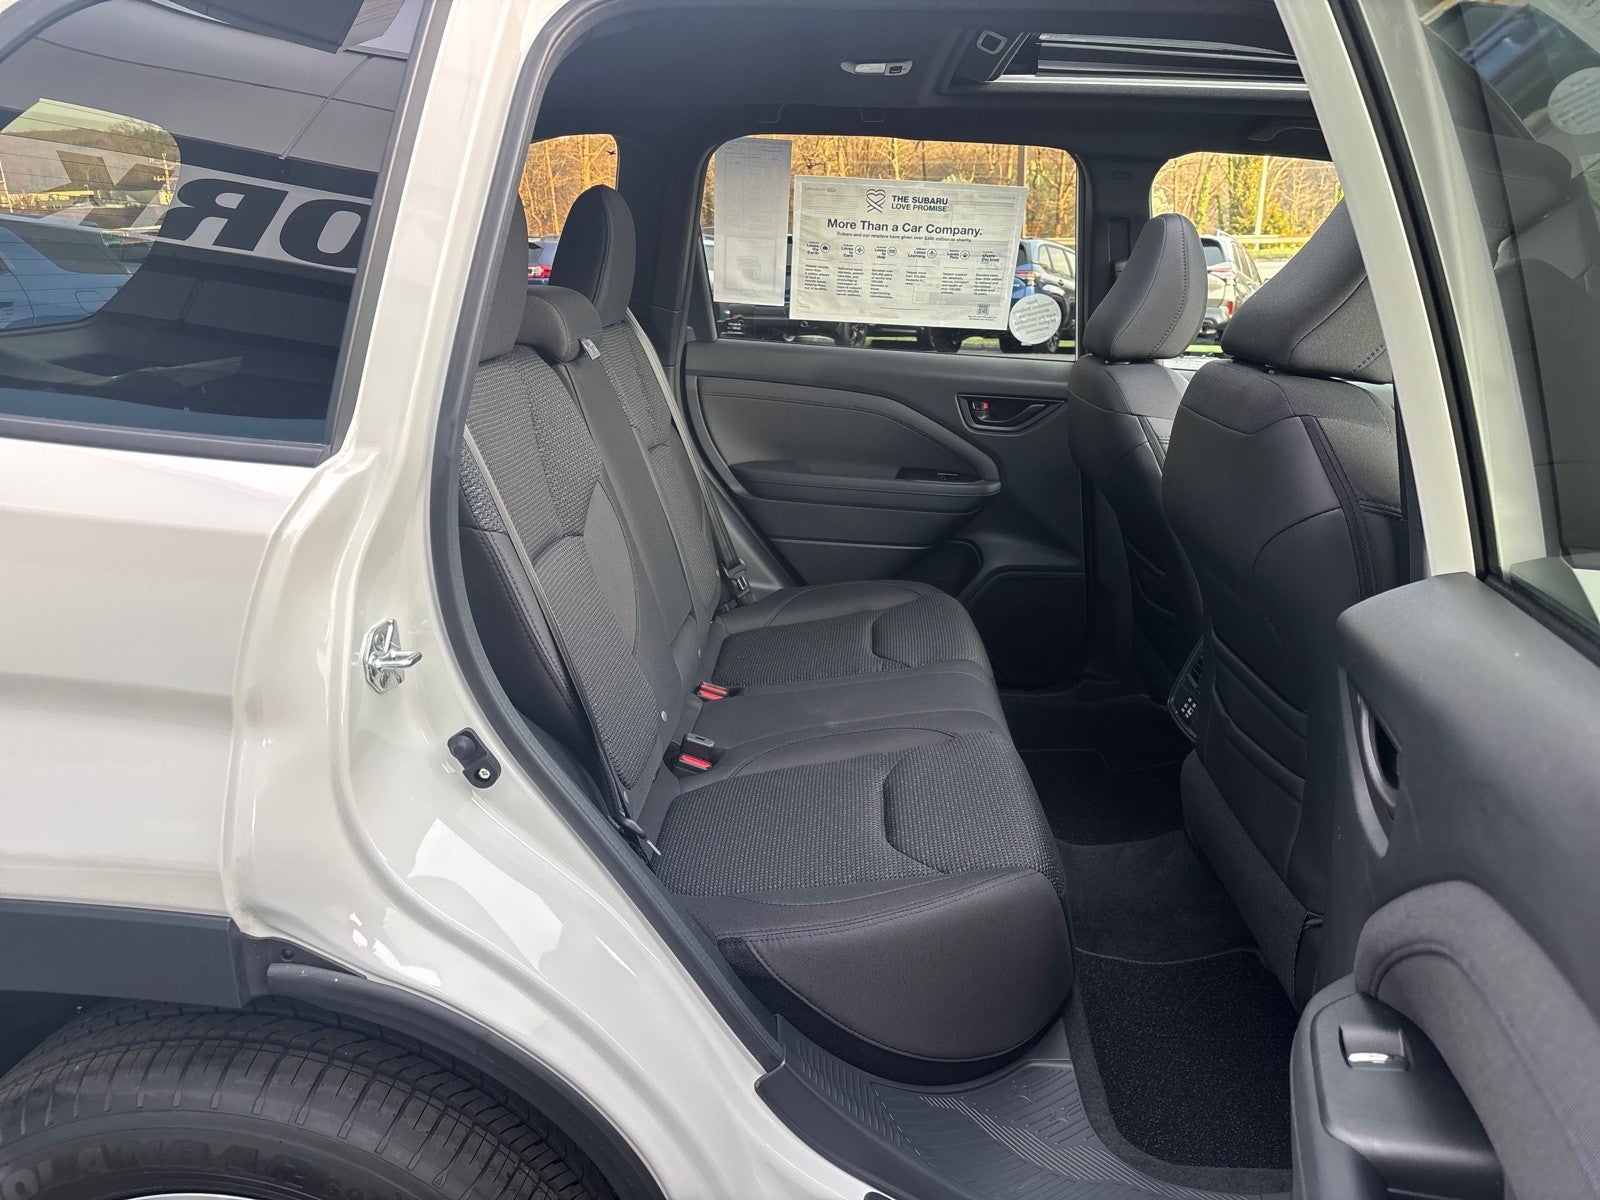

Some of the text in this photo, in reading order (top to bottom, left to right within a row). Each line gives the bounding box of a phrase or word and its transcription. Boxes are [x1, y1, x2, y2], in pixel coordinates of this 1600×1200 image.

[891, 195, 948, 206] THE SUBARU
[891, 203, 949, 212] LOVE PROMISE
[827, 218, 857, 230] More
[860, 220, 888, 232] Than
[902, 223, 923, 233] Car
[926, 224, 982, 237] Company.
